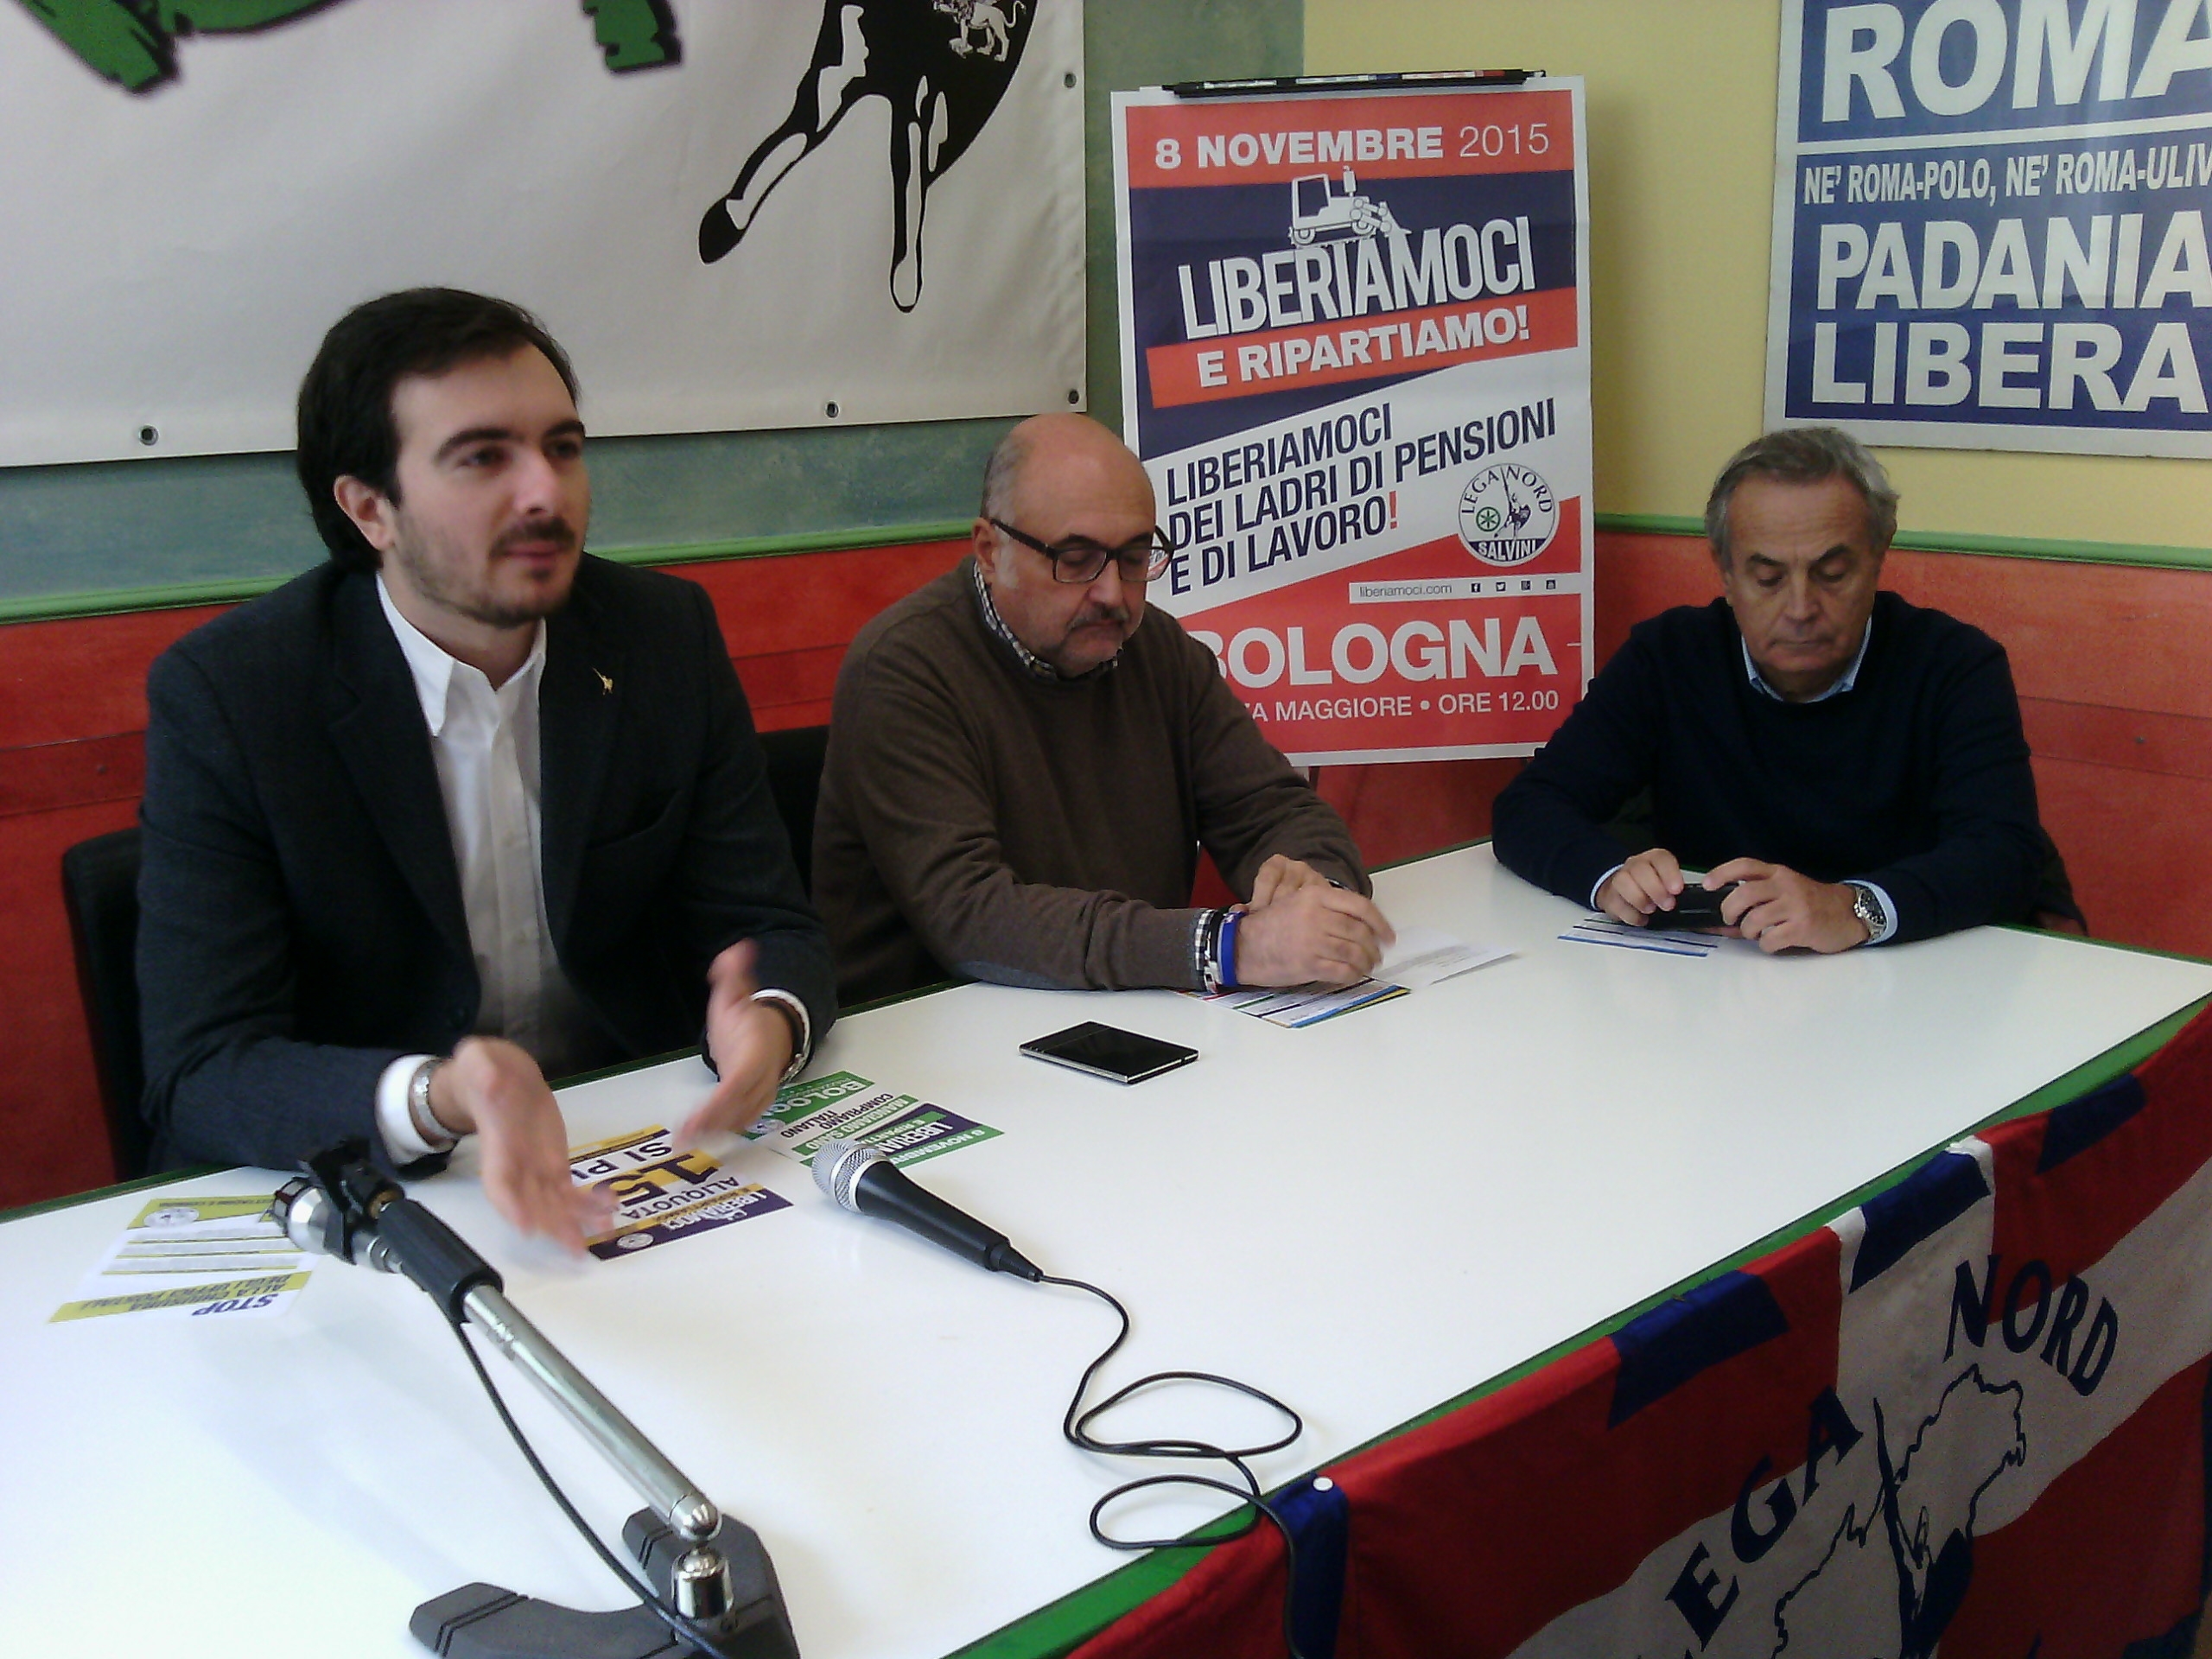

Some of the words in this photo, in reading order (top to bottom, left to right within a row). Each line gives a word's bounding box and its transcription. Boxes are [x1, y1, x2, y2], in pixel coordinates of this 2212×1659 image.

[1822, 0, 2212, 123] ROMA
[1155, 138, 1181, 169] 8
[1198, 127, 1444, 168] NOVEMBRE
[1459, 124, 1550, 157] 2015
[1847, 157, 1997, 207] ROMA-POLO,
[1178, 216, 1536, 340] LIBERIAMOCI
[1817, 210, 2212, 310] PADANIA
[1197, 351, 1227, 388] E
[1238, 305, 1530, 383] RIPARTIAMO!
[1812, 321, 2209, 414] LIBERA
[1166, 403, 1391, 506] LIBERIAMOCI
[1168, 493, 1224, 551] DEI
[1235, 463, 1338, 527] LADRI
[1349, 451, 1383, 497] DI
[1395, 397, 1555, 483] PENSIONI
[1461, 470, 1500, 514] LEGA
[1505, 465, 1553, 513] NORD
[1171, 554, 1191, 595] E
[1202, 540, 1236, 587] DI
[1247, 491, 1398, 573] LAVORO!
[1478, 540, 1537, 562] SALVINI
[1359, 583, 1452, 598] liberiamoci.com
[1275, 696, 1412, 721] MAGGIORE
[1437, 692, 1492, 715] ORE
[1498, 690, 1560, 713] 12.00
[764, 1081, 866, 1116] BOLOG
[821, 1093, 893, 1129] COMPRIAMO
[781, 1109, 837, 1139] ITALIANO
[624, 1141, 672, 1162] SI
[621, 1176, 740, 1219] ALIQUOTA
[191, 1294, 280, 1317] STOP
[1637, 1386, 1864, 1659] EGA
[1943, 1255, 2119, 1397] NORD
